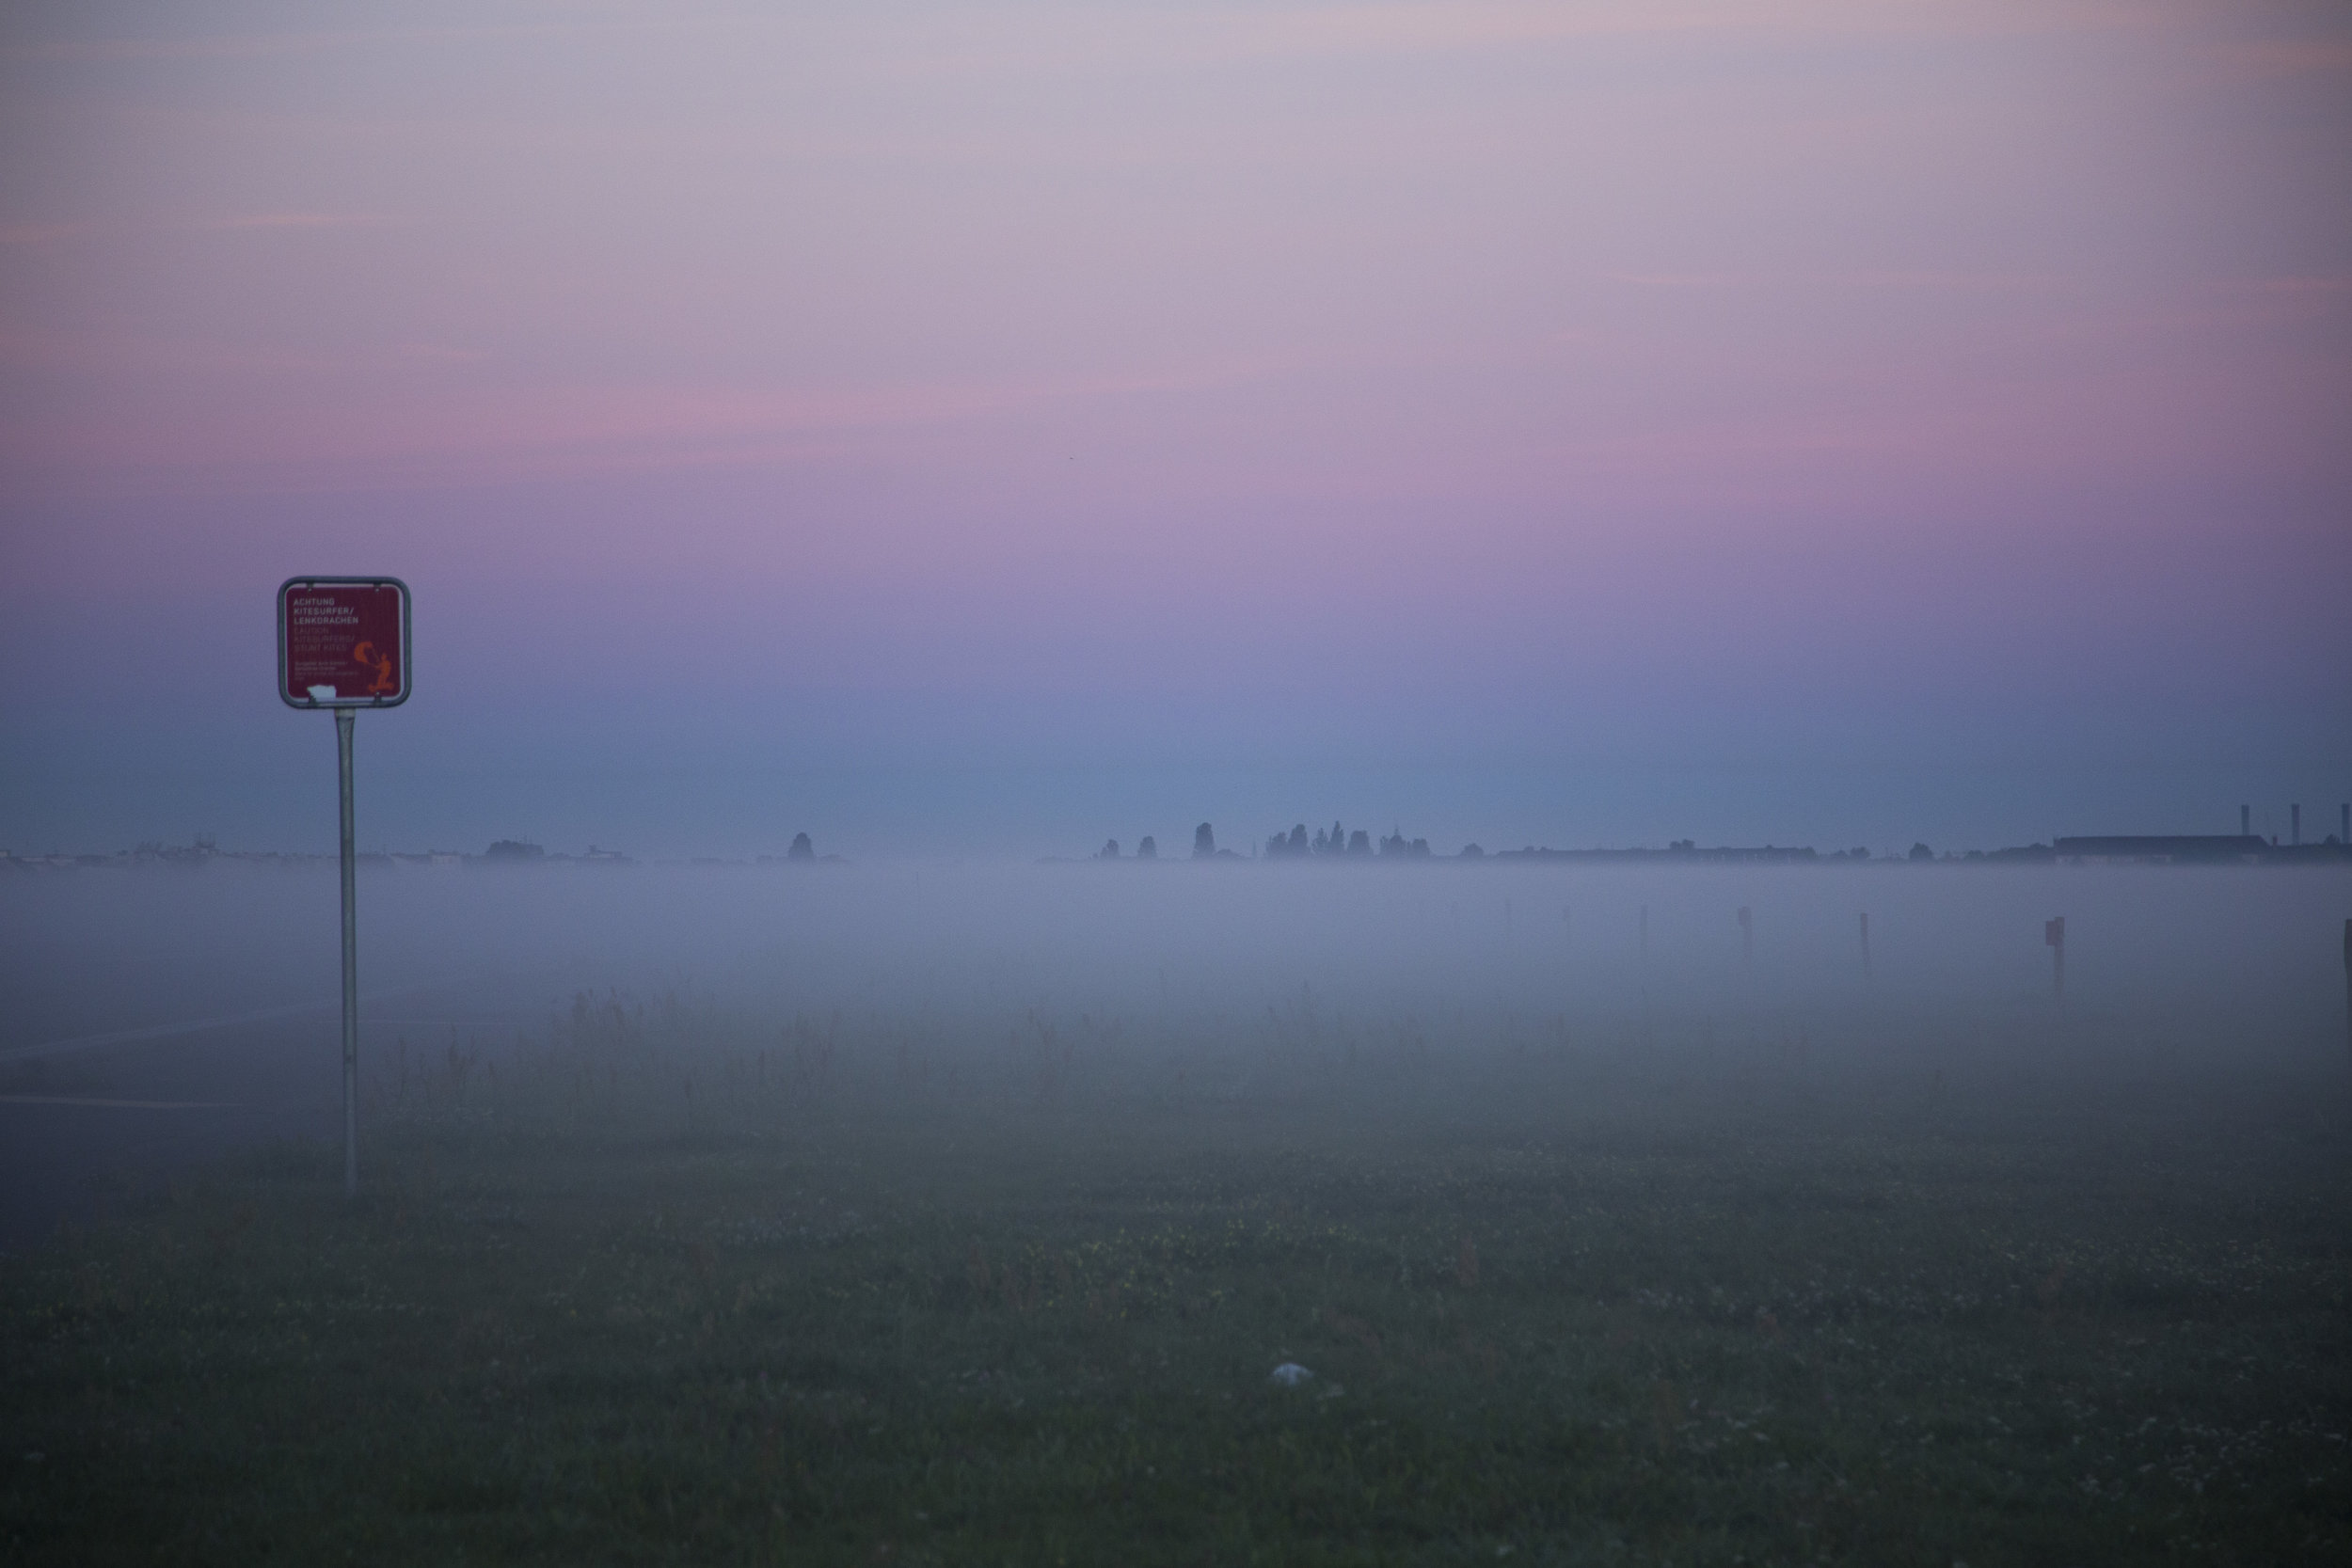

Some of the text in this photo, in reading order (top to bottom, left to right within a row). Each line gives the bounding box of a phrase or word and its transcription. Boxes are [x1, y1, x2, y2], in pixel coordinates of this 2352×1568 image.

[294, 597, 335, 606] ACHTUNG
[294, 607, 354, 615] KITESURFER/
[294, 616, 359, 625] LENKDRACHEN
